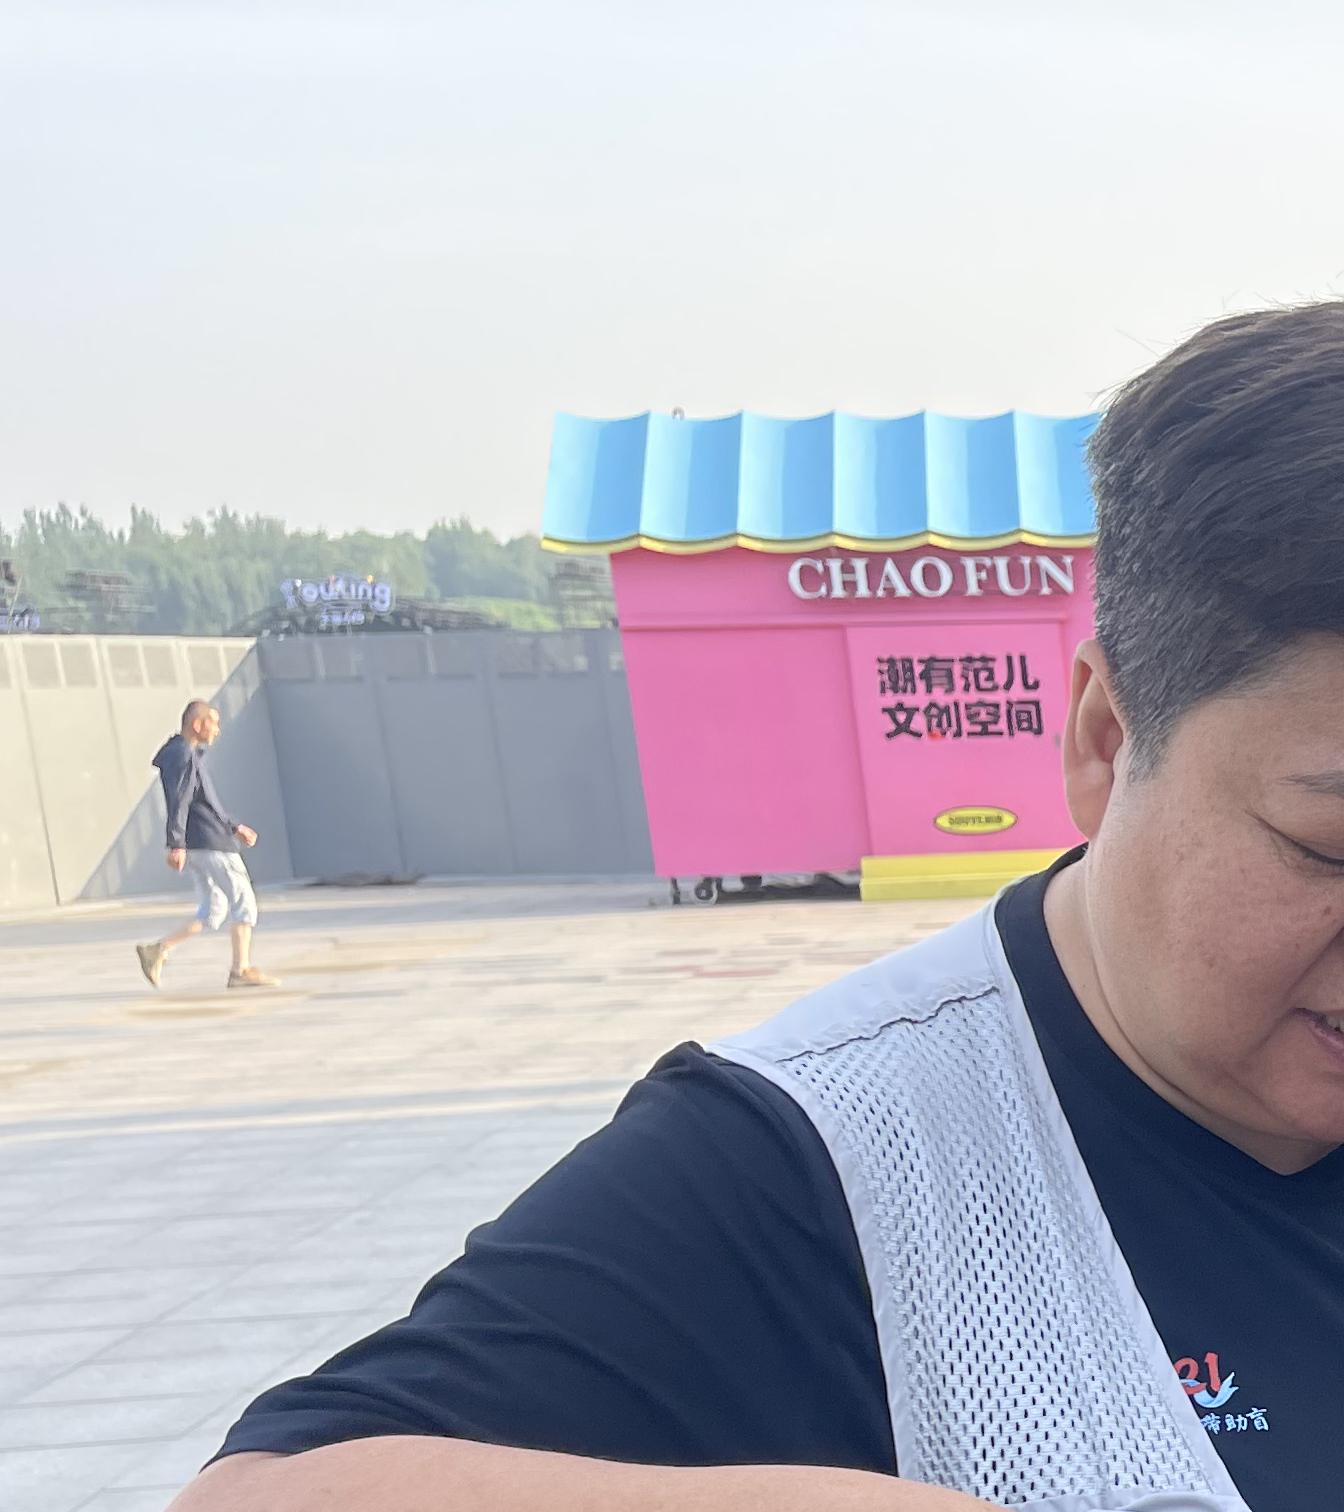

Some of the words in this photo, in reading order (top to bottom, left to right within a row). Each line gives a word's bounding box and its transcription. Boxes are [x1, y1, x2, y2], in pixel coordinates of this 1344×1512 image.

[787, 557, 954, 599] CHAO
[964, 556, 1076, 596] FUN
[877, 654, 1040, 694] 潮有范儿
[882, 700, 1044, 740] 文创空间
